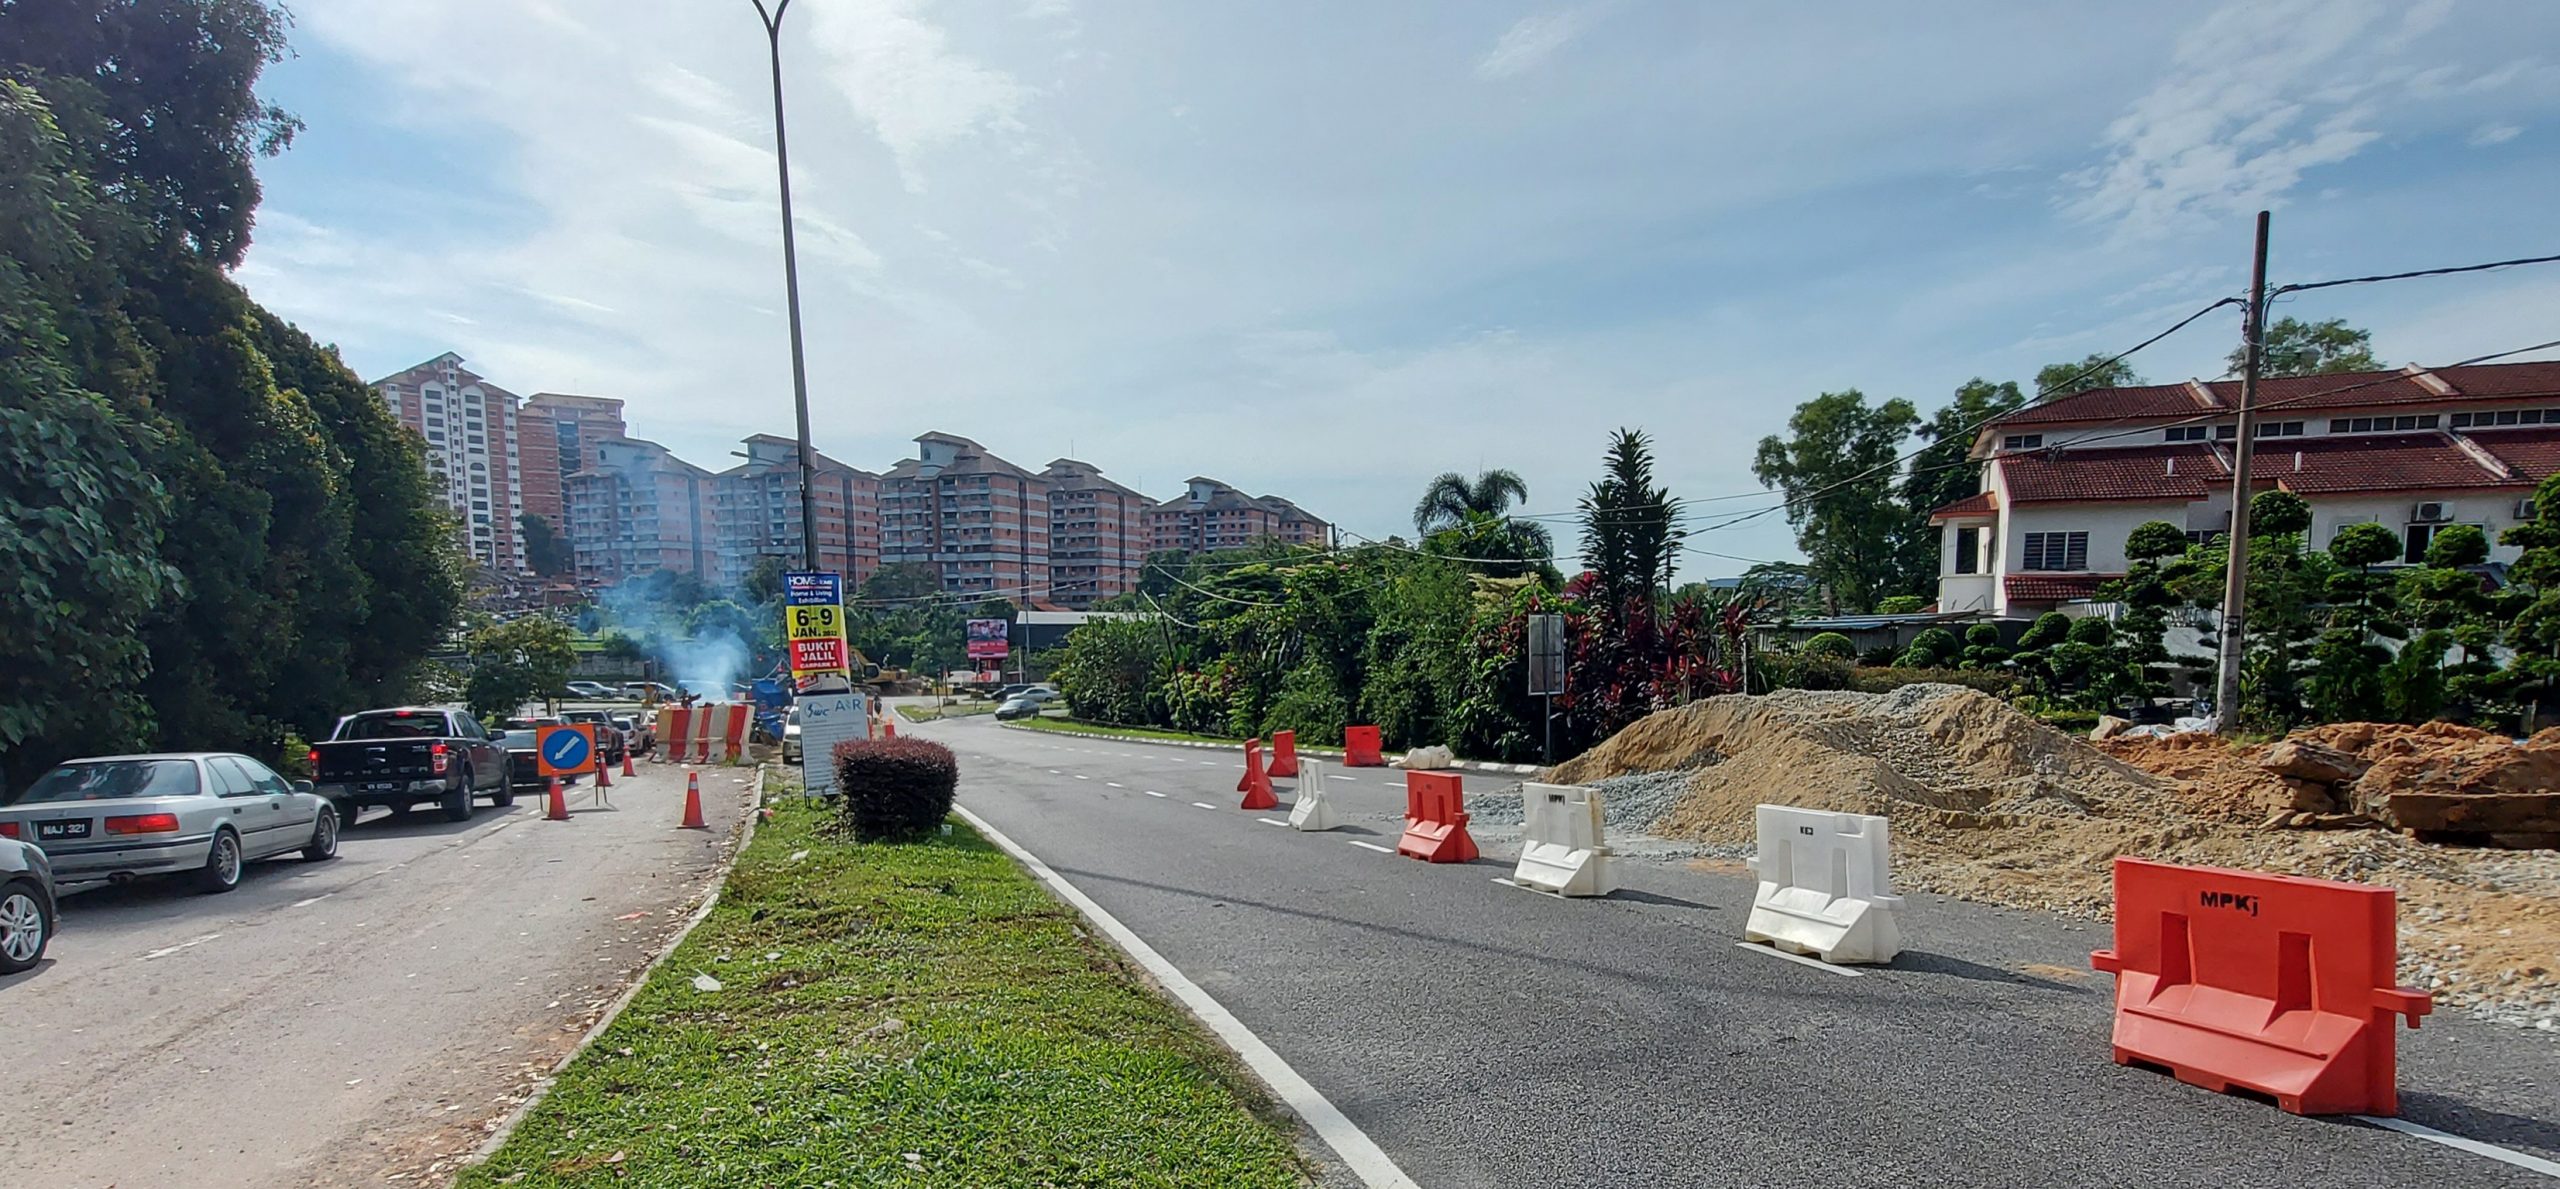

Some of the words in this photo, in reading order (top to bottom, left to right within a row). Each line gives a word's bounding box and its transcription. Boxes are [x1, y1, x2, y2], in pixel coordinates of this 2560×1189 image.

[796, 608, 833, 626] 6-9
[798, 641, 836, 653] BUKIT
[801, 652, 835, 662] JALIL
[67, 823, 85, 833] 321
[2200, 890, 2259, 917] MPKj
